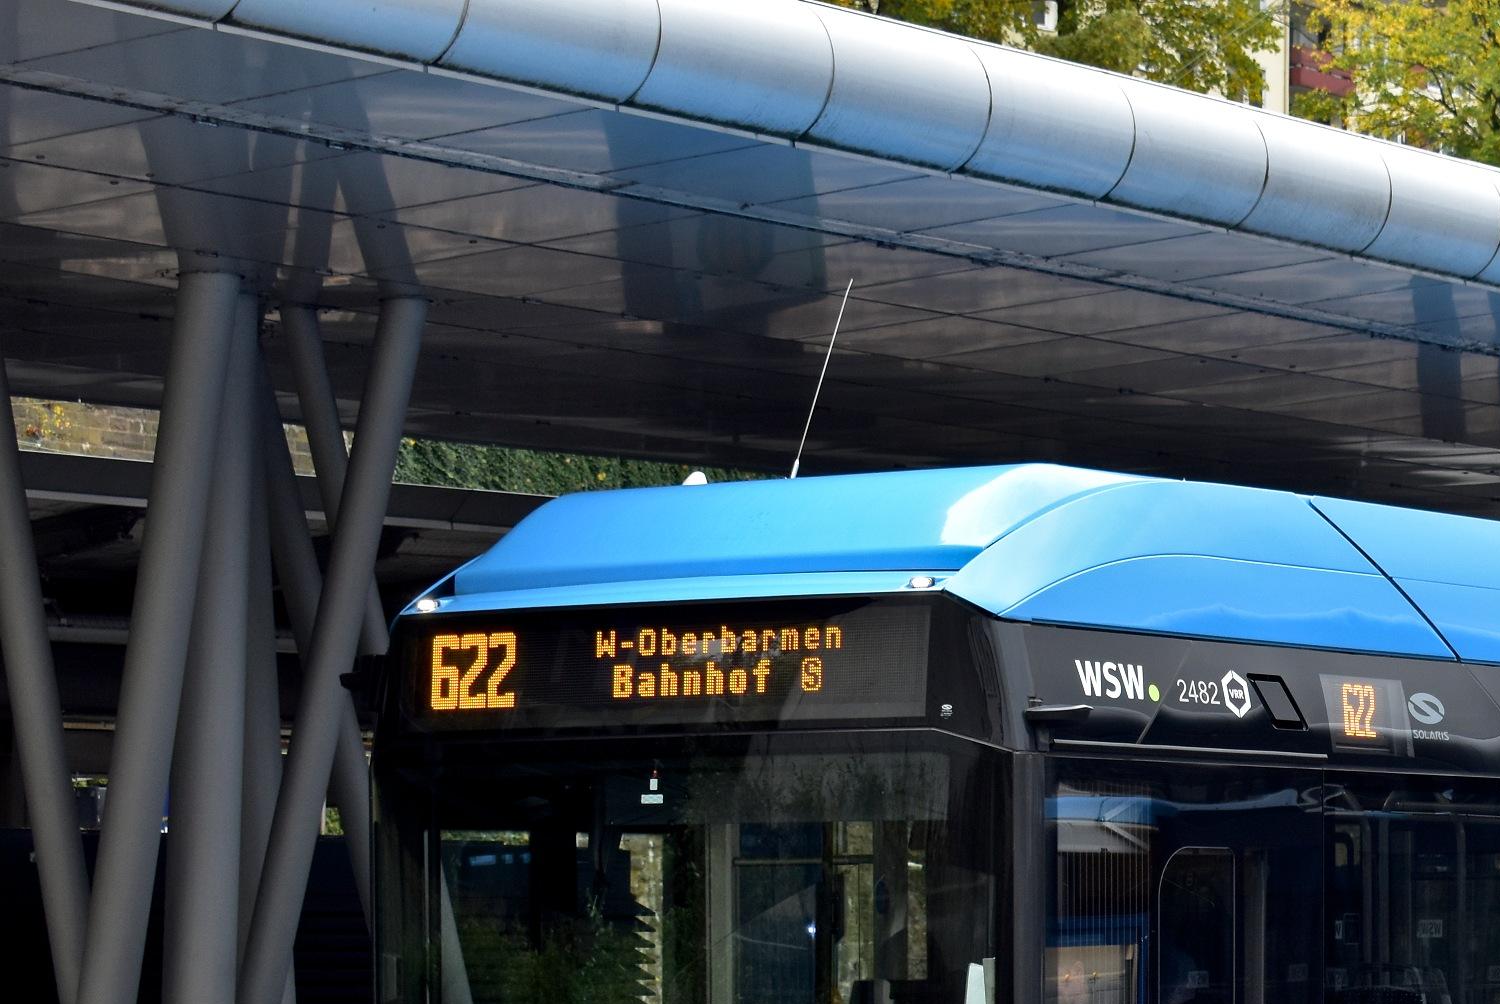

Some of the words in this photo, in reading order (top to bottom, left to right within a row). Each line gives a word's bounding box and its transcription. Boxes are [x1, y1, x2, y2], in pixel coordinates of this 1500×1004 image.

[596, 625, 842, 658] W-Oberbarmen
[431, 632, 516, 710] 622
[613, 659, 771, 698] Bahnhof
[1176, 679, 1221, 705] 2482
[1228, 688, 1245, 700] VRR
[1342, 683, 1377, 738] 622
[1412, 729, 1450, 741] SOLARIS
